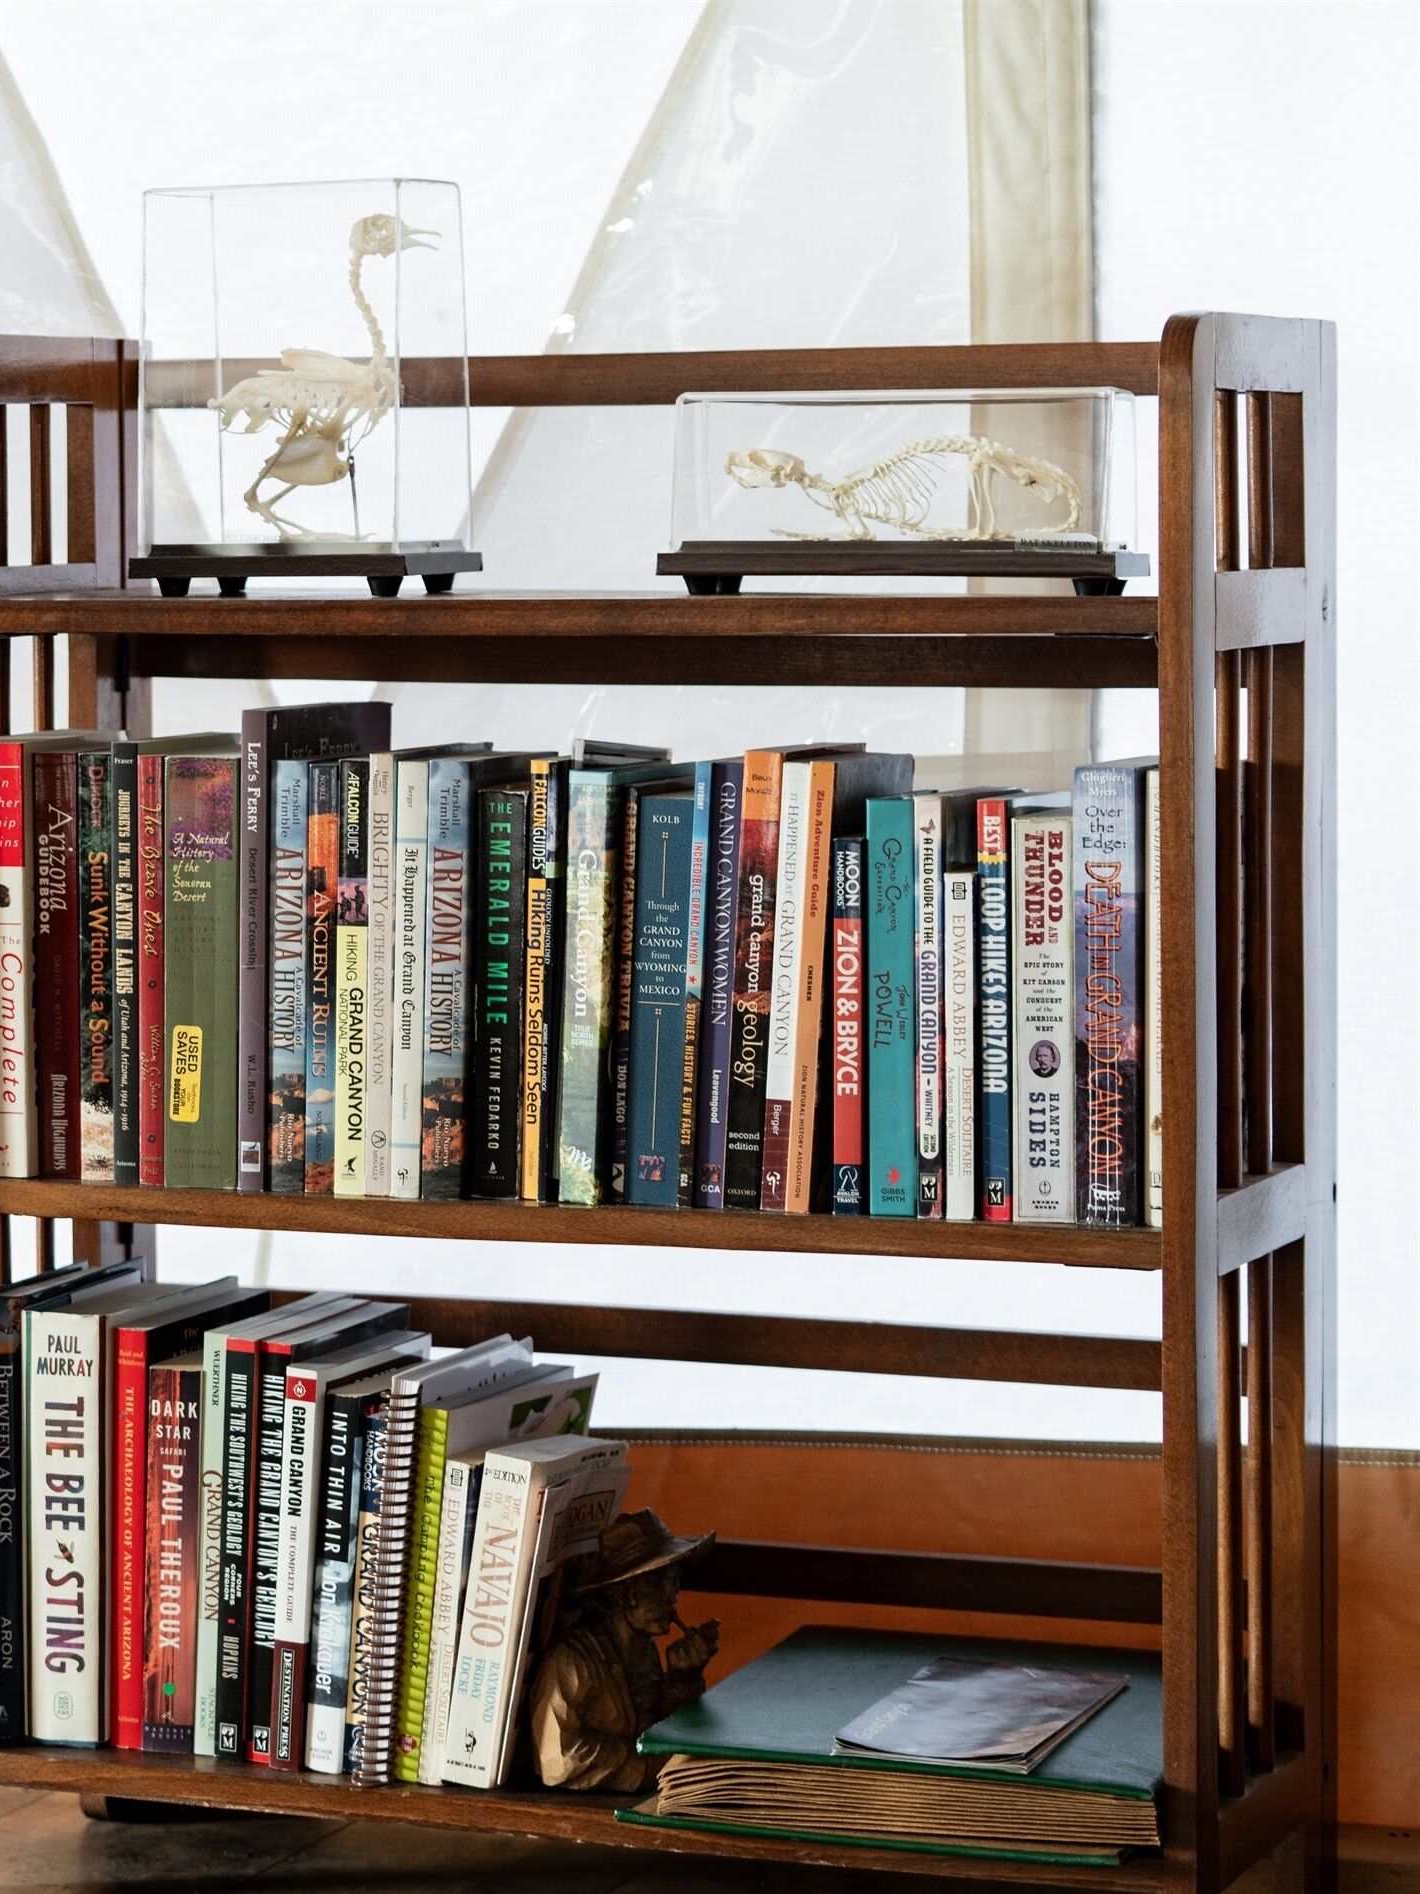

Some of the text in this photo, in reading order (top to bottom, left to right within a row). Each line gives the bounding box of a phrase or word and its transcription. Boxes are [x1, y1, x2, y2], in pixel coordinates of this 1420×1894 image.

[280, 787, 290, 838] Trimble
[292, 778, 301, 825] Marshall
[319, 774, 327, 801] NOBLE
[489, 802, 513, 814] THE
[652, 815, 680, 824] KOLB
[48, 804, 73, 911] Arizona
[247, 848, 257, 883] Desert
[809, 790, 825, 917] Zion Adventure Guide
[924, 848, 934, 874] FIELD
[983, 816, 1001, 849] BEST
[39, 834, 49, 934] GUIDEBOOK
[116, 789, 134, 994] JOURNEYS IN THE CANYON LANDS
[247, 888, 257, 914] River
[274, 847, 303, 961] ARIZONA
[618, 802, 637, 1031] GRAND CANYON TRIVIA
[689, 842, 704, 965] INCREDIBLE GRAND CANYON
[711, 782, 737, 1026] GRAND CANYON WOMEN
[843, 850, 860, 907] MOON
[923, 877, 934, 907] GUIDE
[924, 910, 933, 922] TO
[1025, 831, 1044, 946] THUNDER
[1048, 831, 1063, 943] BLOOD AND
[1084, 860, 1122, 950] DEATH
[246, 918, 257, 970] Crossing
[372, 812, 389, 1085] BRIGHTY OF THE GRAND CANYON
[399, 848, 419, 1050] It Happened at Grand Canyon
[486, 822, 512, 1025] EMERALD MILE
[571, 849, 598, 1017] Grand Canyon
[640, 938, 683, 947] CANYON
[641, 927, 681, 935] GRAND
[746, 875, 764, 993] grand canyon
[924, 925, 934, 944] THE
[89, 851, 109, 1083] Sunk Without a Sound
[311, 890, 330, 1078] ANCIENT RUINS
[527, 889, 546, 1124] Hiking Ruins Seldom Seen
[634, 962, 687, 972] WYOMING
[638, 985, 680, 995] MEXICO
[873, 971, 893, 1048] POWELL
[920, 950, 938, 1005] GRAND
[953, 915, 967, 1058] EDWARD ABBEY
[982, 877, 1007, 1093] LOOP HIKES ARIZONA
[175, 1032, 188, 1075] SAVES
[187, 1035, 198, 1072] USED
[272, 970, 295, 1053] HISTORY
[346, 934, 362, 1141] HIKING GRAND CANYON
[734, 1000, 759, 1088] geology
[836, 930, 859, 1095] ZION & BRYCE
[920, 1009, 938, 1075] CANYON
[1084, 973, 1124, 1062] GRAND
[51, 1074, 68, 1170] ARIZONA HIGHWAYS
[487, 1038, 502, 1150] KEVIN FEDARKO
[711, 1069, 721, 1123] Leavengood
[771, 1105, 782, 1135] Berger
[1029, 1092, 1046, 1169] SIDES
[1049, 1093, 1060, 1169] HAMPTON
[1085, 1069, 1123, 1176] CANYON
[37, 1357, 93, 1377] MURRAY
[47, 1334, 81, 1353] PAUL
[151, 1400, 198, 1419] DARK
[156, 1425, 191, 1440] STAR
[160, 1447, 186, 1456] SAFARI
[287, 1406, 306, 1517] GRAND CANYON
[325, 1411, 349, 1553] INTO THIN AIR
[45, 1396, 85, 1673] THE BEE STING
[122, 1387, 134, 1680] THE ARCHAEOLOGY OF ANCIENT ARIZONA
[202, 1470, 223, 1621] GRAND CANYON
[255, 1374, 284, 1649] HIKING THE GRAND CANYON'S GEOLOGY
[159, 1464, 183, 1649] PAUL THEROUX
[409, 1476, 435, 1669] The Camping Cookbook
[466, 1522, 518, 1647] NAVAJO
[1, 1616, 13, 1669] ARON
[222, 1636, 239, 1679] HOPKINS
[315, 1573, 339, 1693] Jon Krakauer
[457, 1657, 472, 1695] LOCKE
[471, 1658, 486, 1700] FRIDAY
[482, 1661, 501, 1723] RAYMOND
